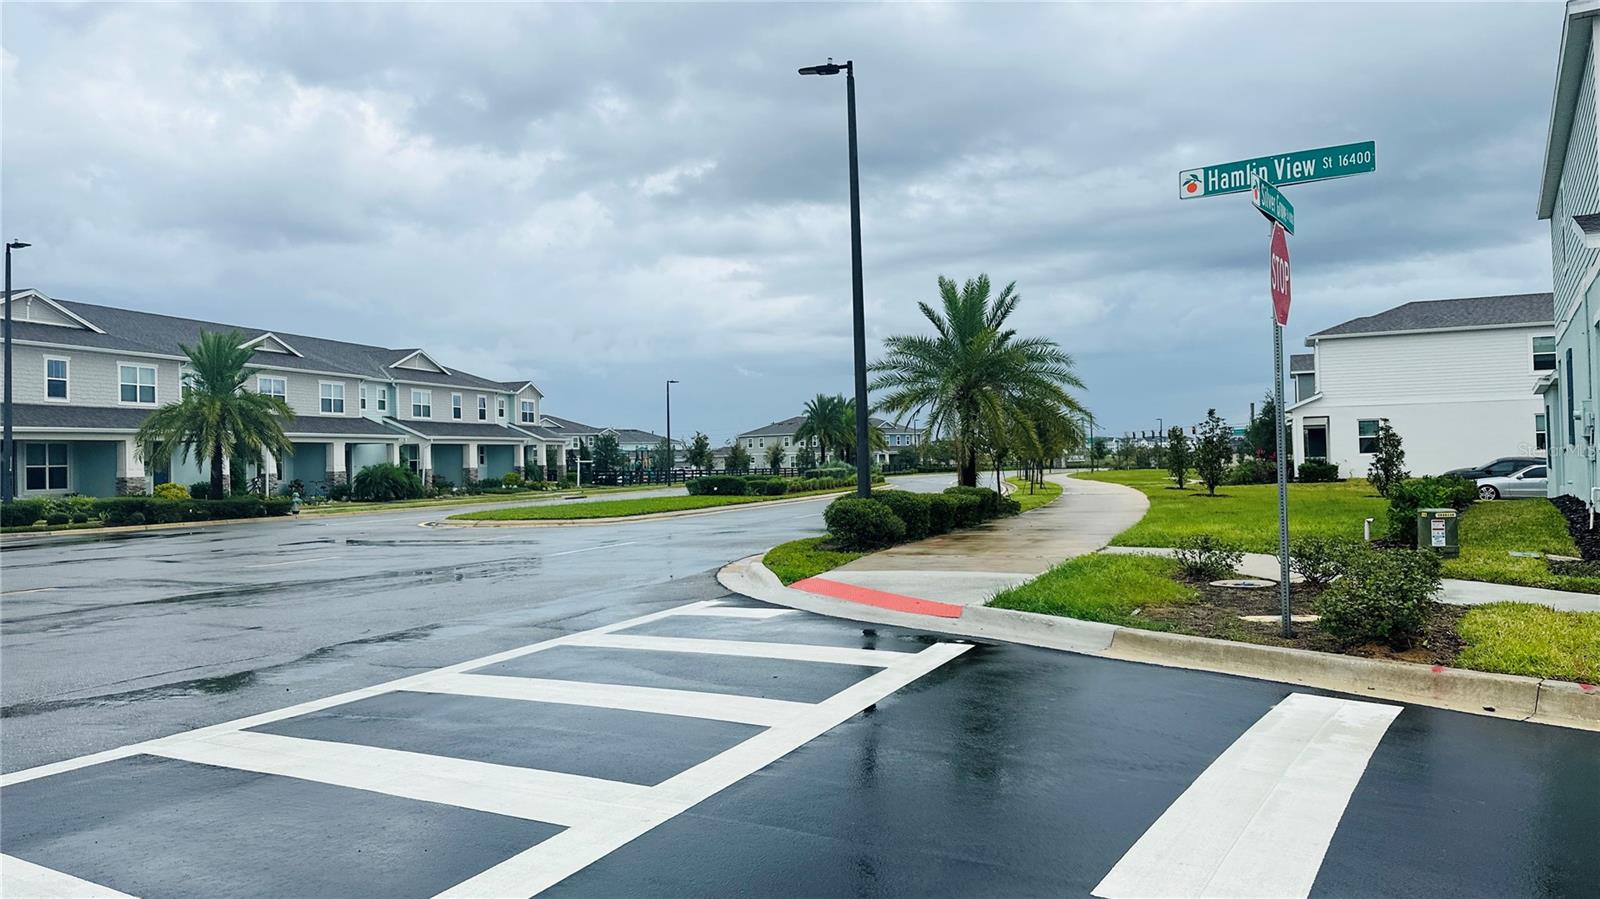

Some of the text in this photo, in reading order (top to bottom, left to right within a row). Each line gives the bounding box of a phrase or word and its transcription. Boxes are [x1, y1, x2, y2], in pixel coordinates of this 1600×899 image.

[1274, 157, 1316, 180] View
[1322, 156, 1333, 169] St
[1339, 151, 1371, 167] 16400
[1271, 253, 1290, 295] STOP
